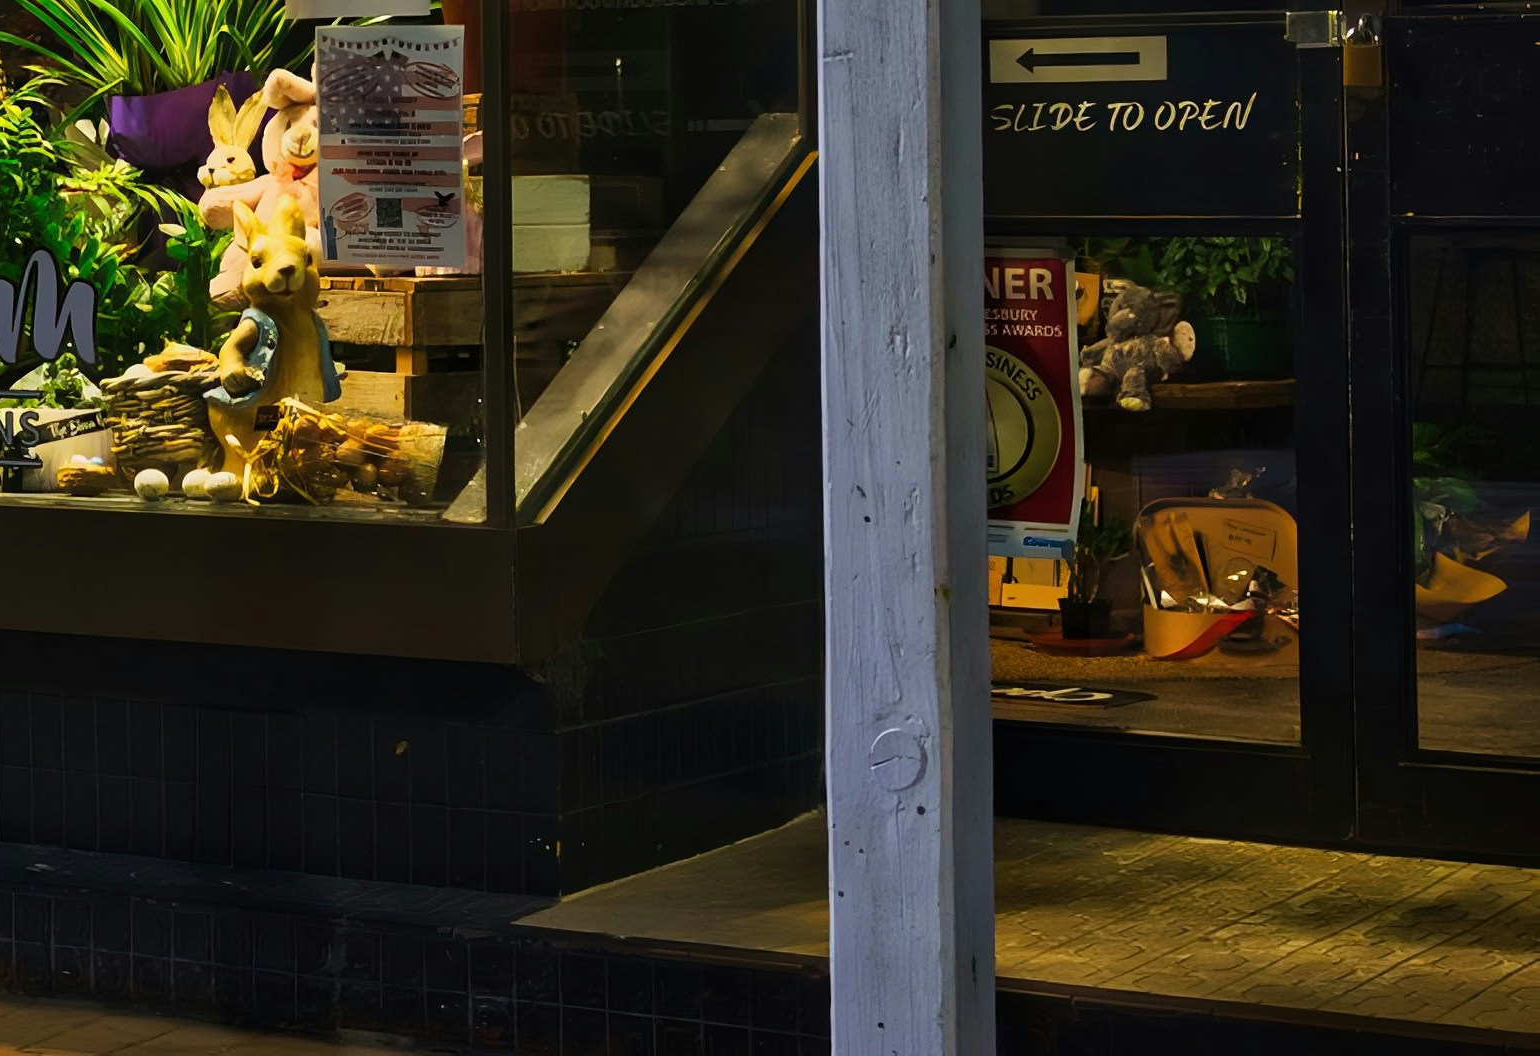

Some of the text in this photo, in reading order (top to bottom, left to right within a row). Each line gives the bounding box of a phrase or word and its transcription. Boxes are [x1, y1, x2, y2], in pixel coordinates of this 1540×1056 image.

[989, 92, 1257, 132] SLIDE TO OPEN
[1002, 324, 1063, 338] AWARDS
